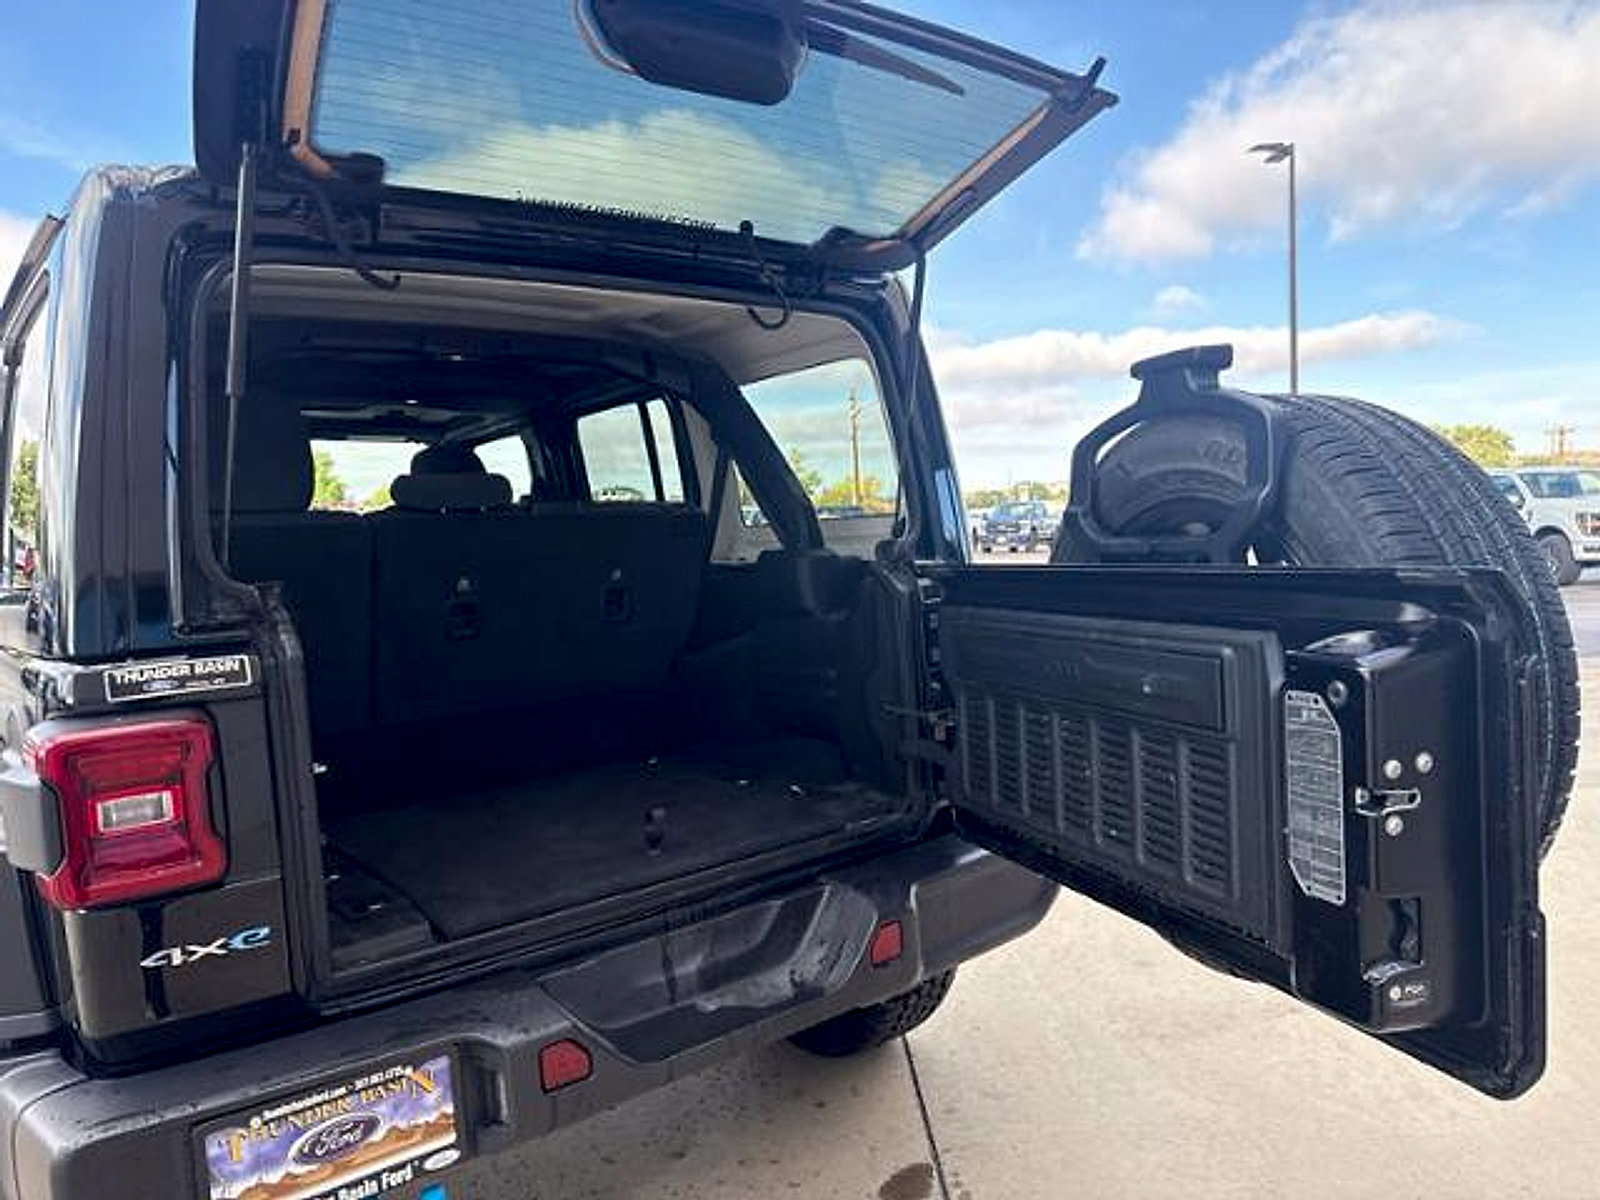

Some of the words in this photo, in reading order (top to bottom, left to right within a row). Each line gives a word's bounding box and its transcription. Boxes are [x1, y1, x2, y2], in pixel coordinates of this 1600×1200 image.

[113, 662, 191, 684] THUNDER
[195, 659, 240, 675] BASIN
[222, 1096, 354, 1163] THUNDER
[359, 1067, 437, 1106] BASIN
[302, 1121, 365, 1156] Ford
[382, 1162, 414, 1188] Ford
